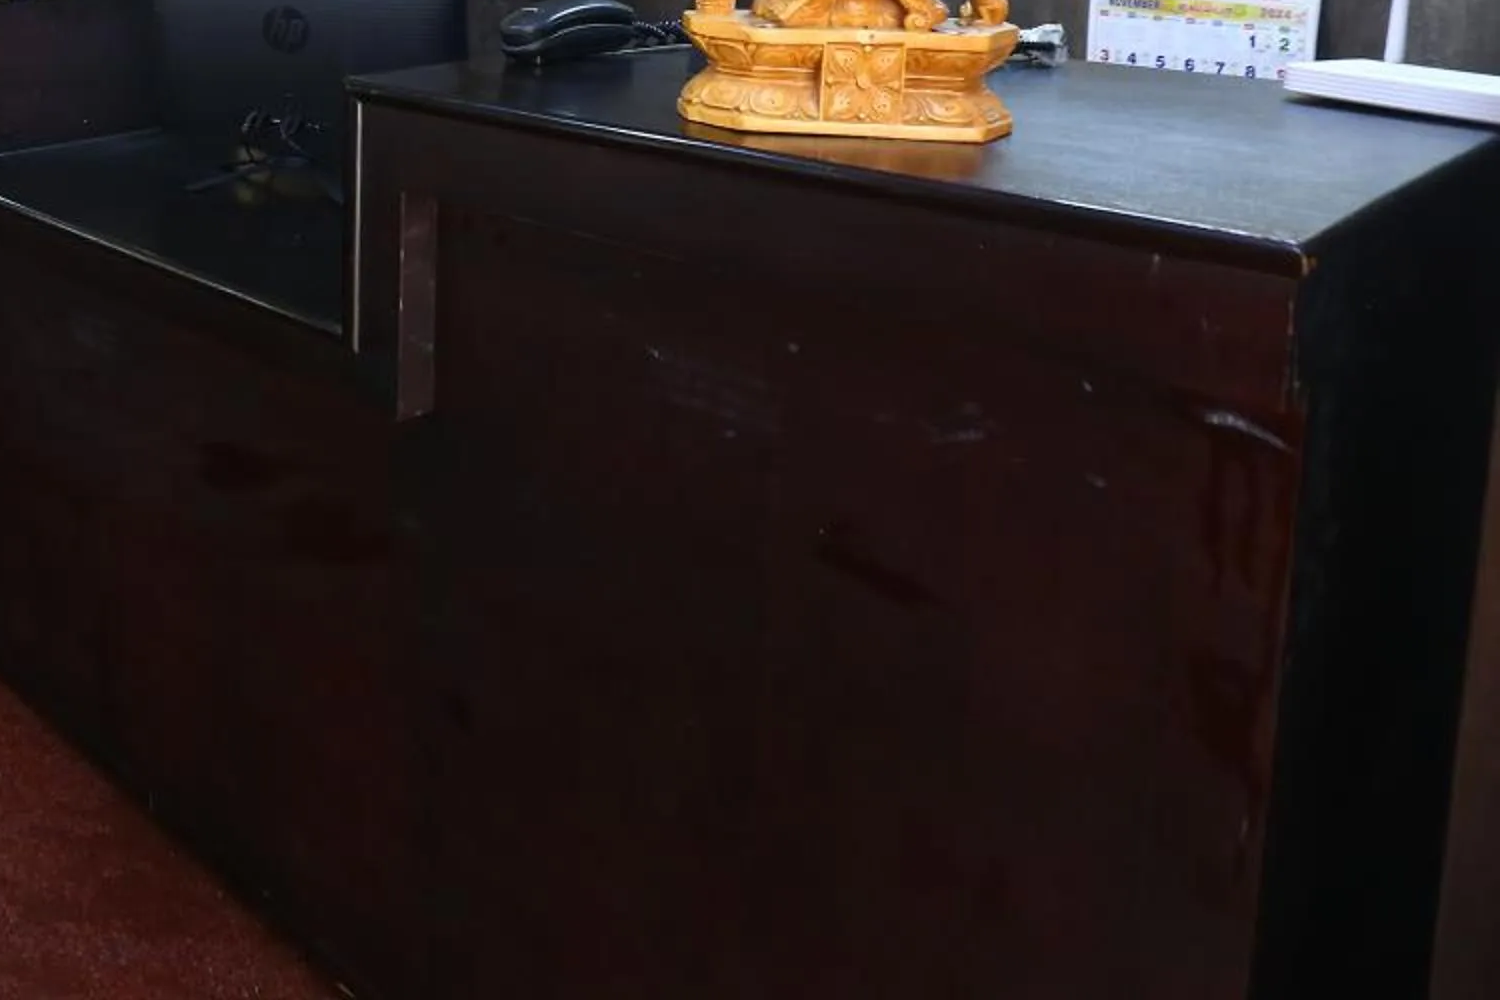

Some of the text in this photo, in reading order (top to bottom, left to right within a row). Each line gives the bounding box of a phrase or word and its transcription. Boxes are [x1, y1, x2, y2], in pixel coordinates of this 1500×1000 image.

[1249, 34, 1290, 51] 1 2
[1099, 49, 1256, 79] 3 4 5 6 7 8
